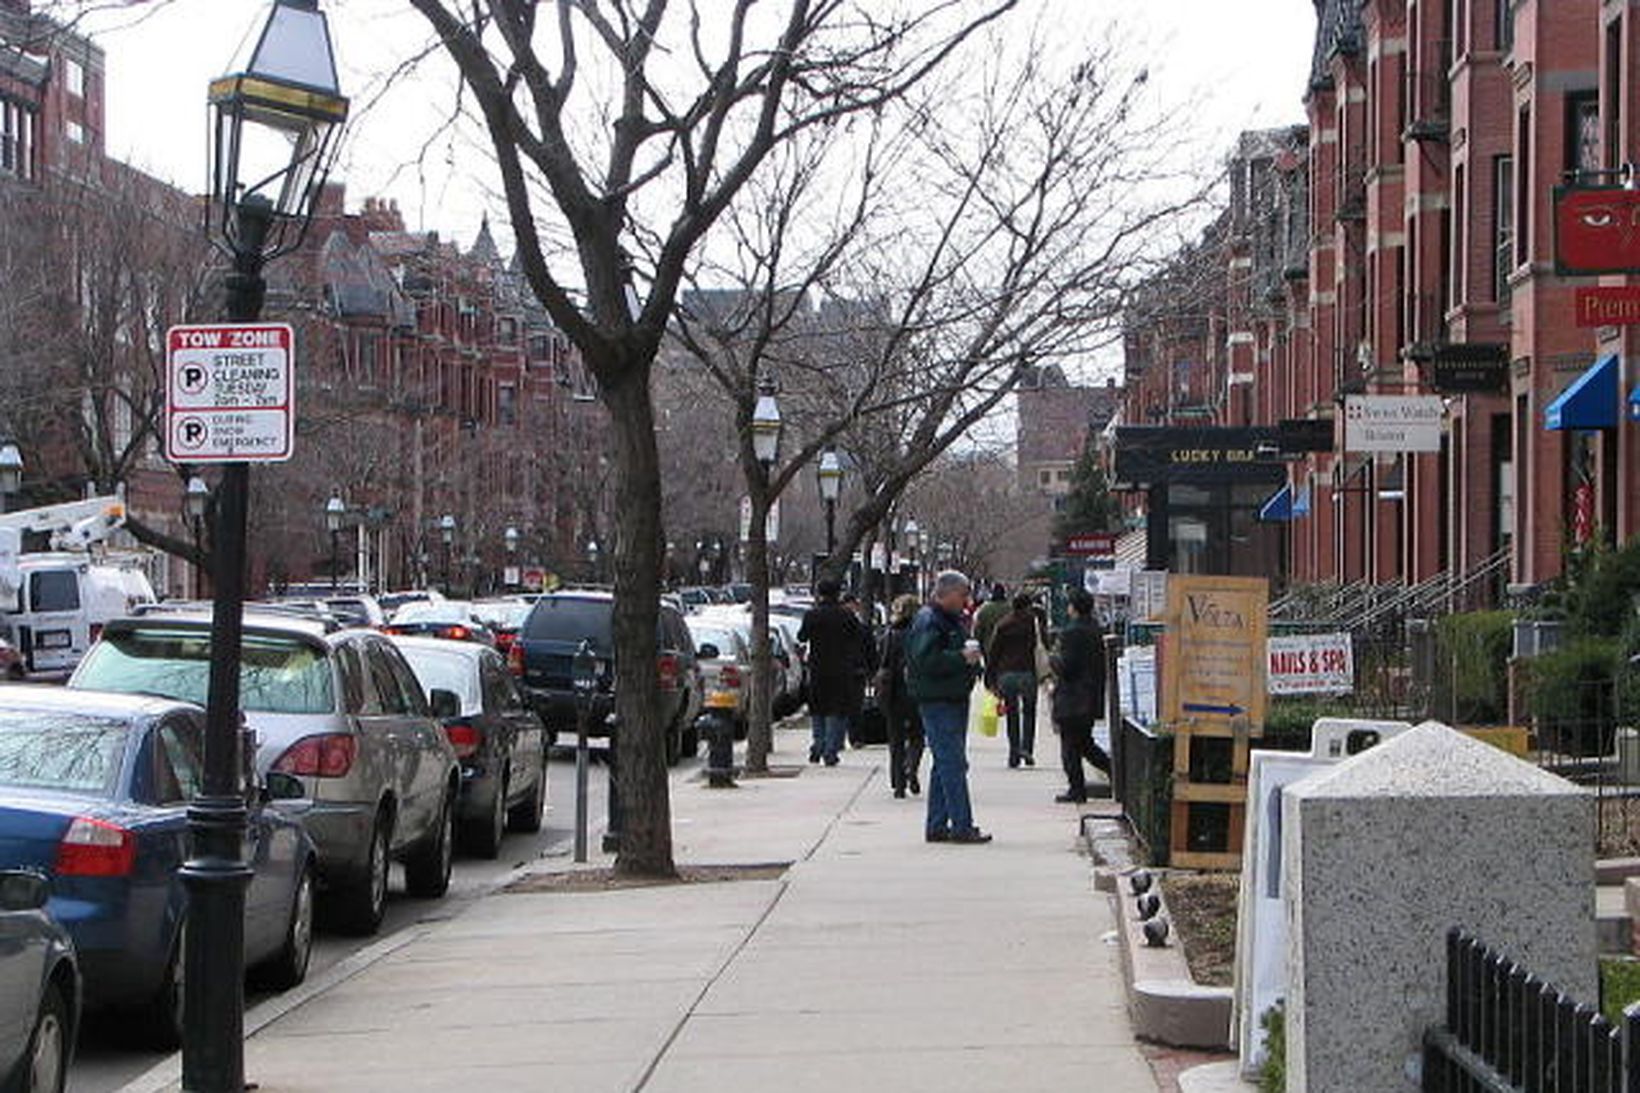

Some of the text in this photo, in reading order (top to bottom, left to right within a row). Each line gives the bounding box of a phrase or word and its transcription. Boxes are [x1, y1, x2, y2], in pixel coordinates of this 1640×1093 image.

[178, 330, 281, 348] TOW ZONE
[212, 353, 264, 367] STREET
[211, 368, 280, 382] CLEANING
[211, 437, 278, 447] EMERGENCY
[1170, 449, 1219, 463] LUCKY
[1270, 648, 1346, 675] NAILS & SPA
